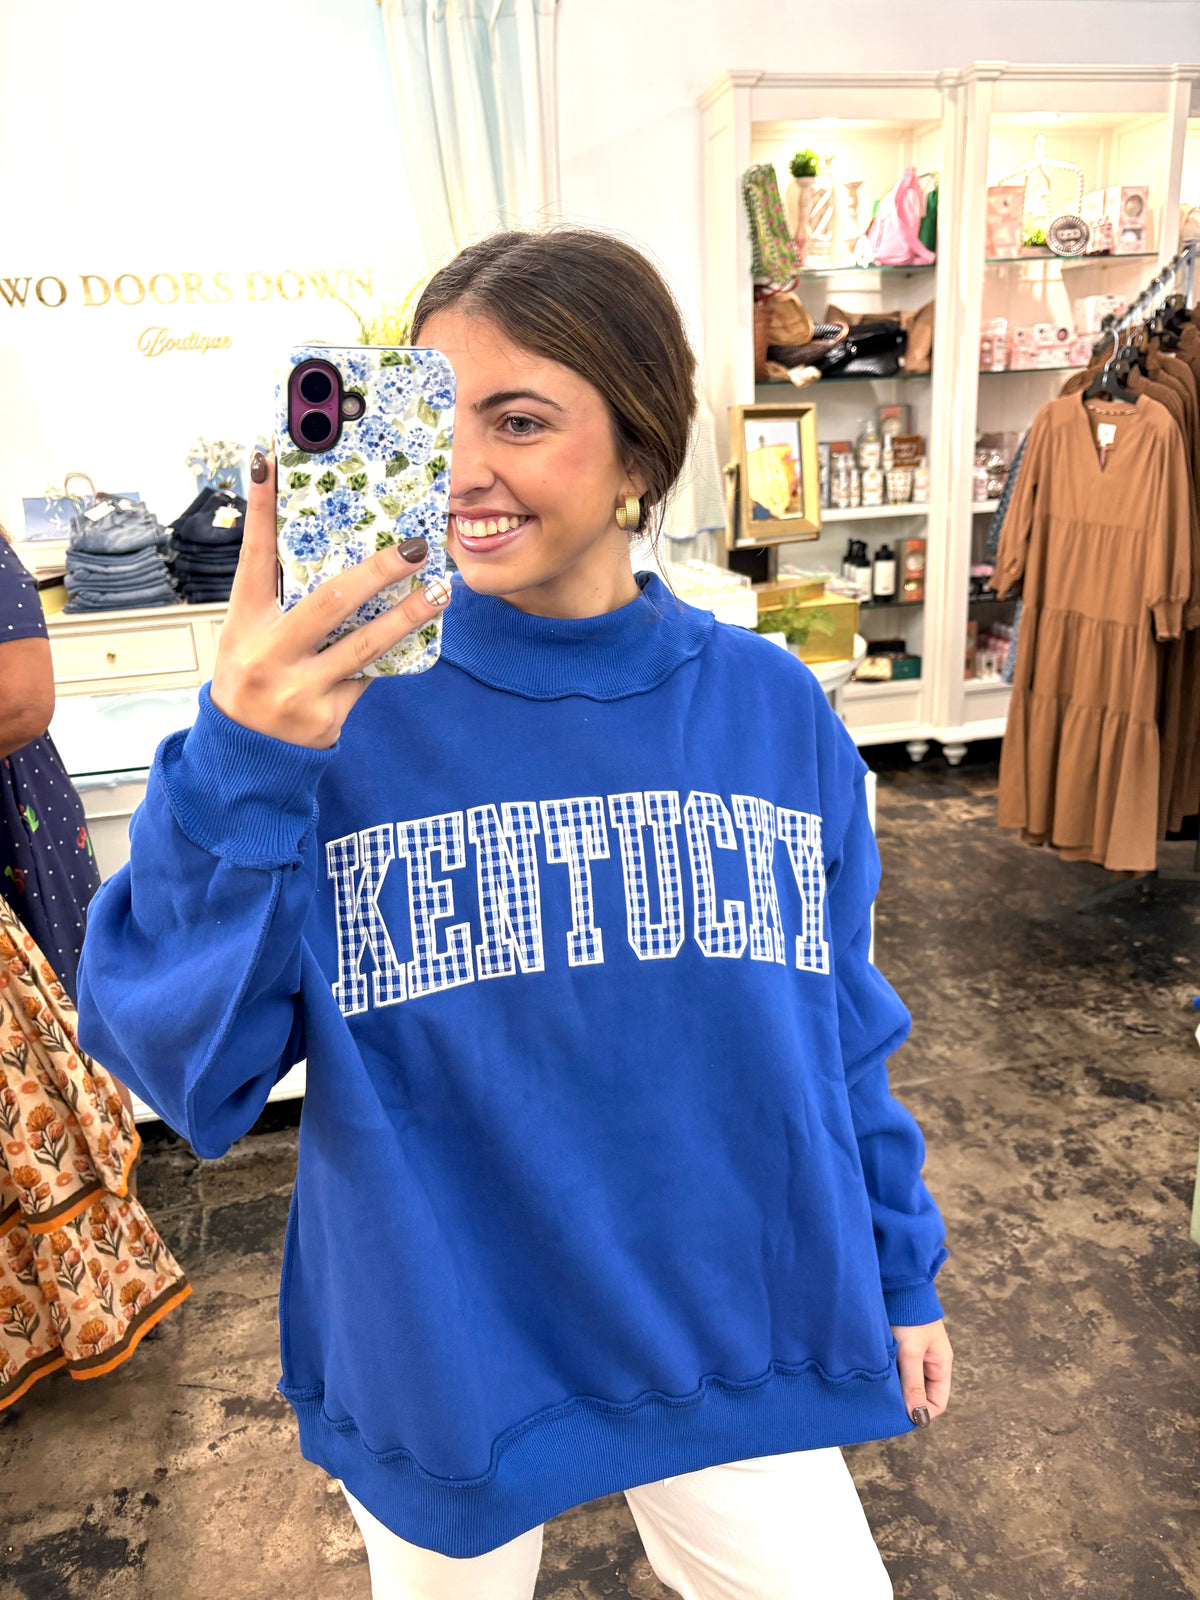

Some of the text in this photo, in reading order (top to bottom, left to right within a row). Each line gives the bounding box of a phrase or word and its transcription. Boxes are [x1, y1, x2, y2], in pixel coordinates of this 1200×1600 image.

[79, 272, 234, 306] DOORS
[246, 267, 374, 301] DOWN
[137, 326, 233, 357] Boutique
[325, 790, 830, 1017] KENTUCKY
